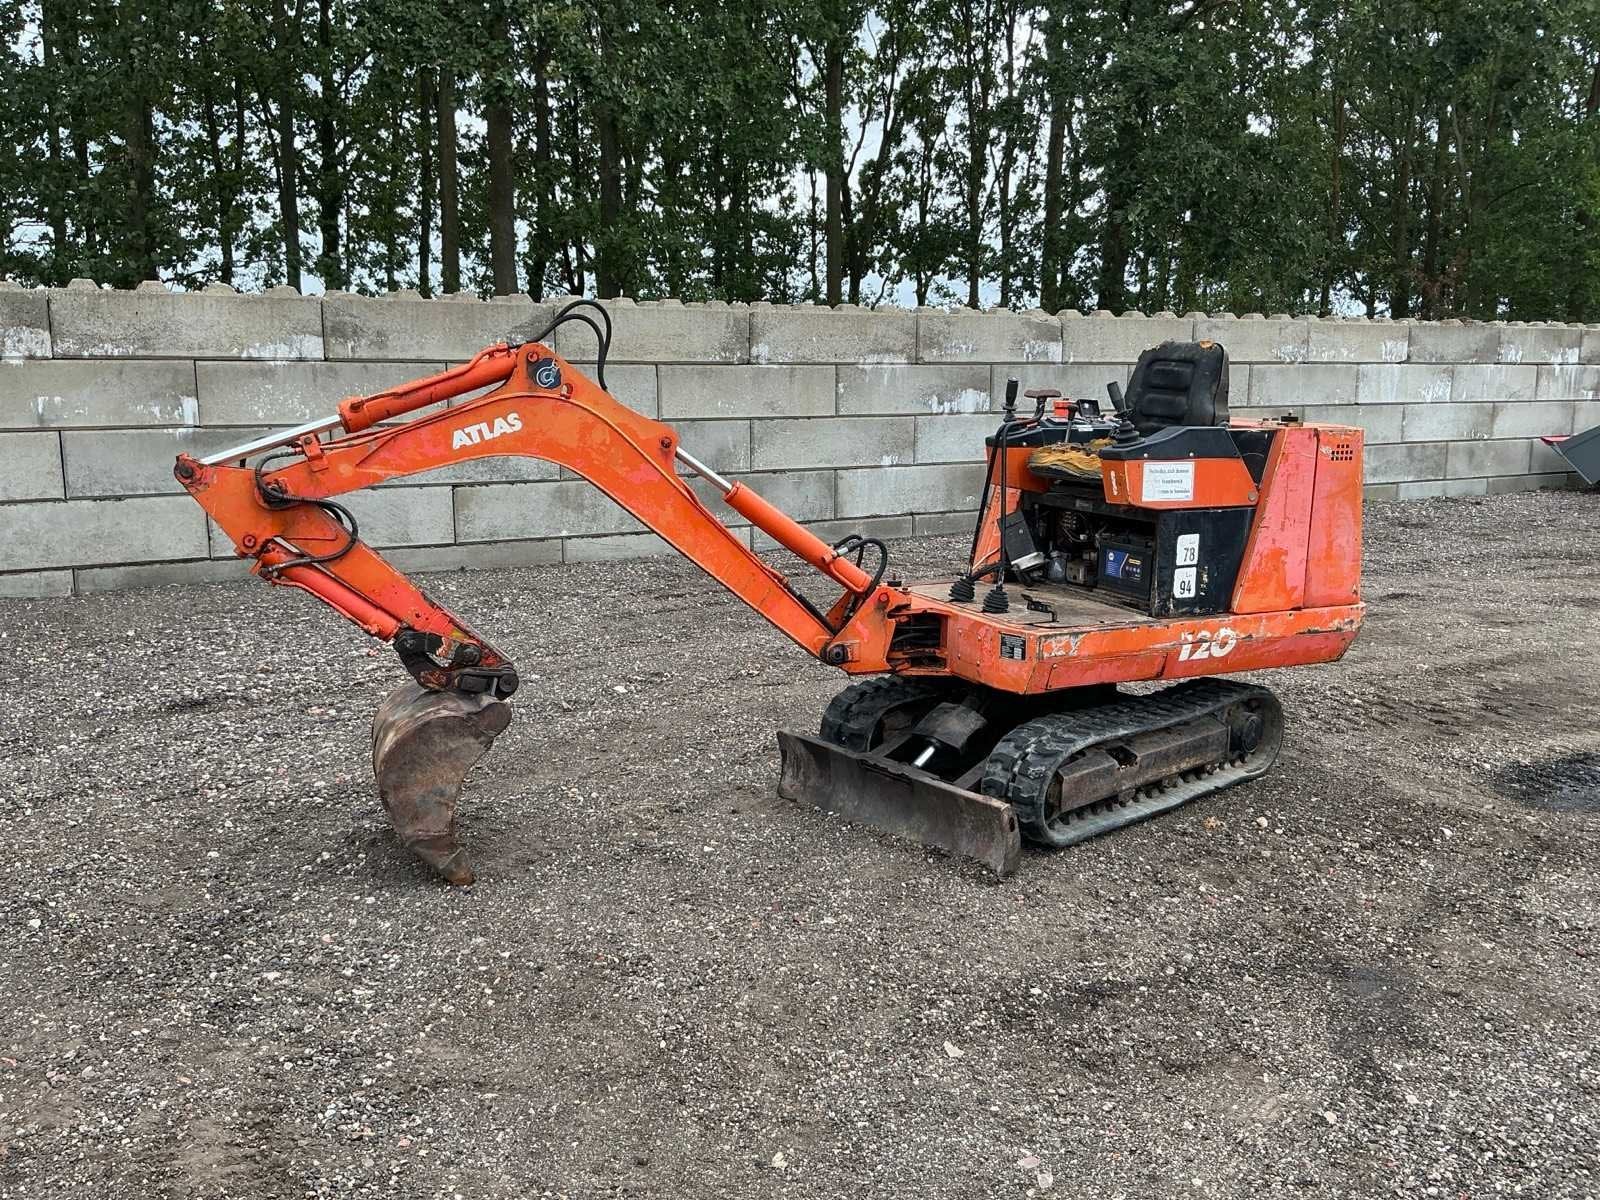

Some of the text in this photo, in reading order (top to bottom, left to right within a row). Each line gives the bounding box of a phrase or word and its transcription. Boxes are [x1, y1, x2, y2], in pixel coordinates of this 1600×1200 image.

[452, 412, 523, 450] ATLAS
[1183, 547, 1196, 562] 78
[1179, 580, 1192, 595] 94
[1178, 626, 1237, 661] 120
